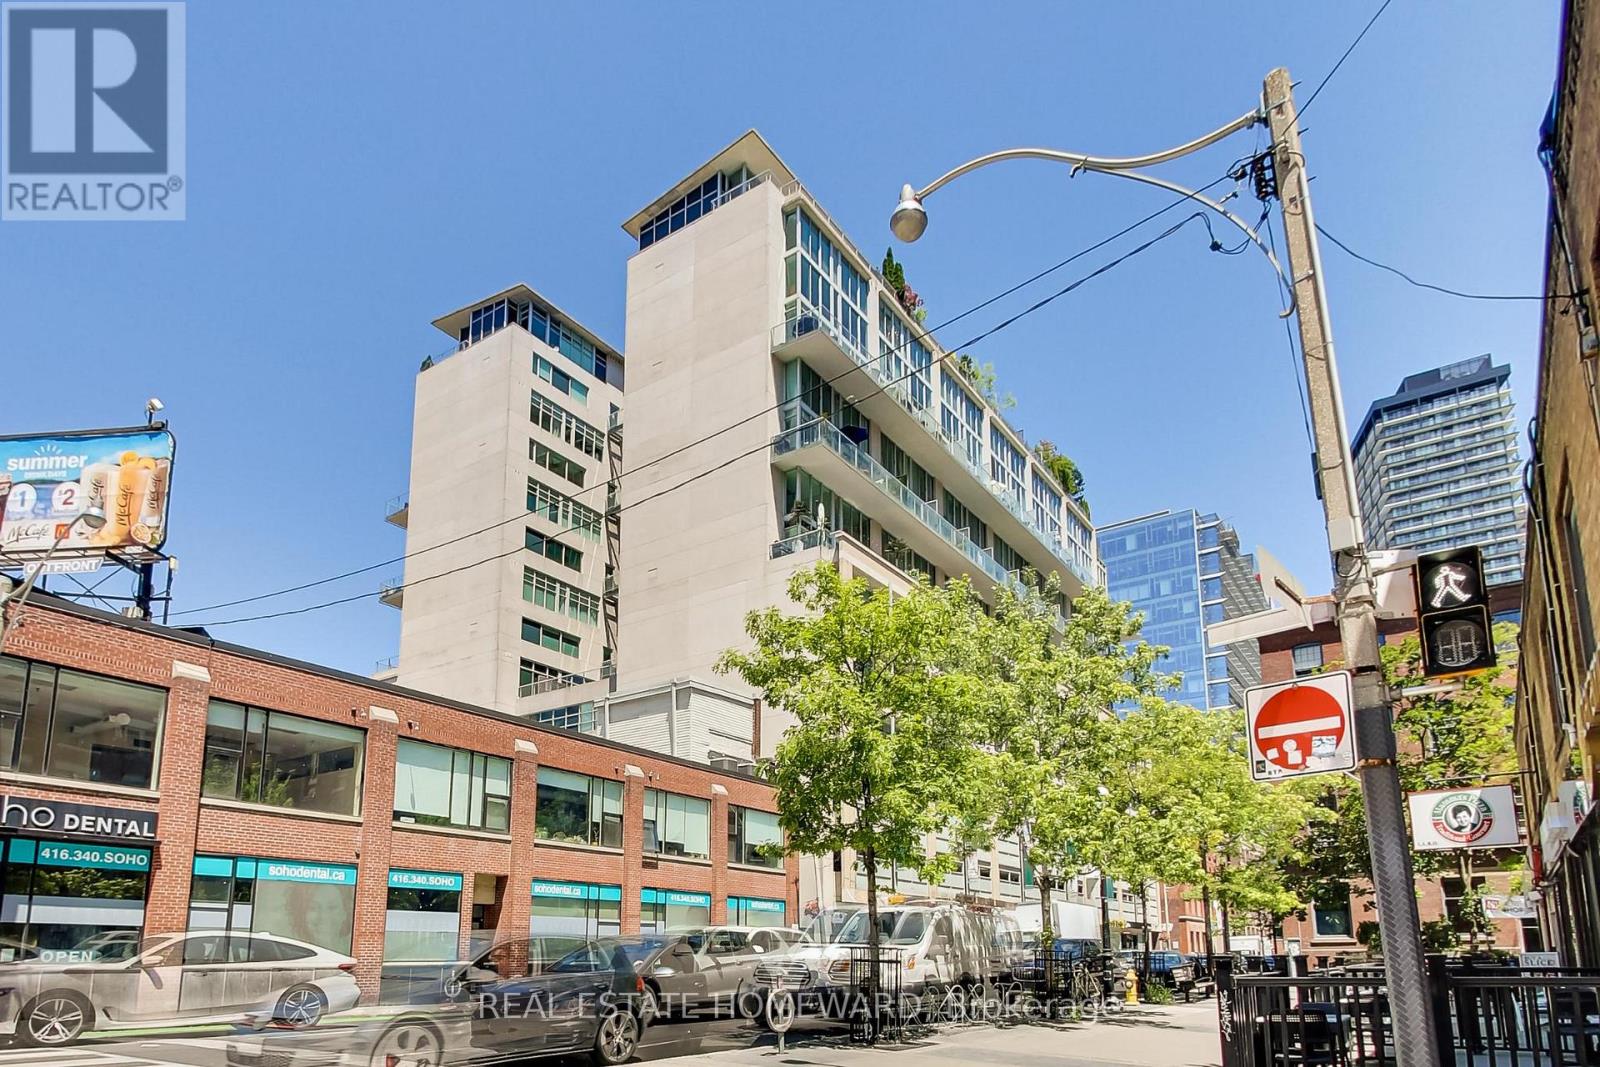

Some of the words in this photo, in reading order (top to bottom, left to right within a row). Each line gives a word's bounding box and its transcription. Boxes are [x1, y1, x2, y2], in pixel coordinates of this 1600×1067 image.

[7, 455, 88, 471] summer
[63, 813, 156, 838] DENTAL
[40, 848, 148, 867] 416.340.SOHO
[268, 864, 346, 881] sohodental.ca
[392, 874, 455, 887] 416.340.SOHO
[39, 950, 94, 964] OPEN
